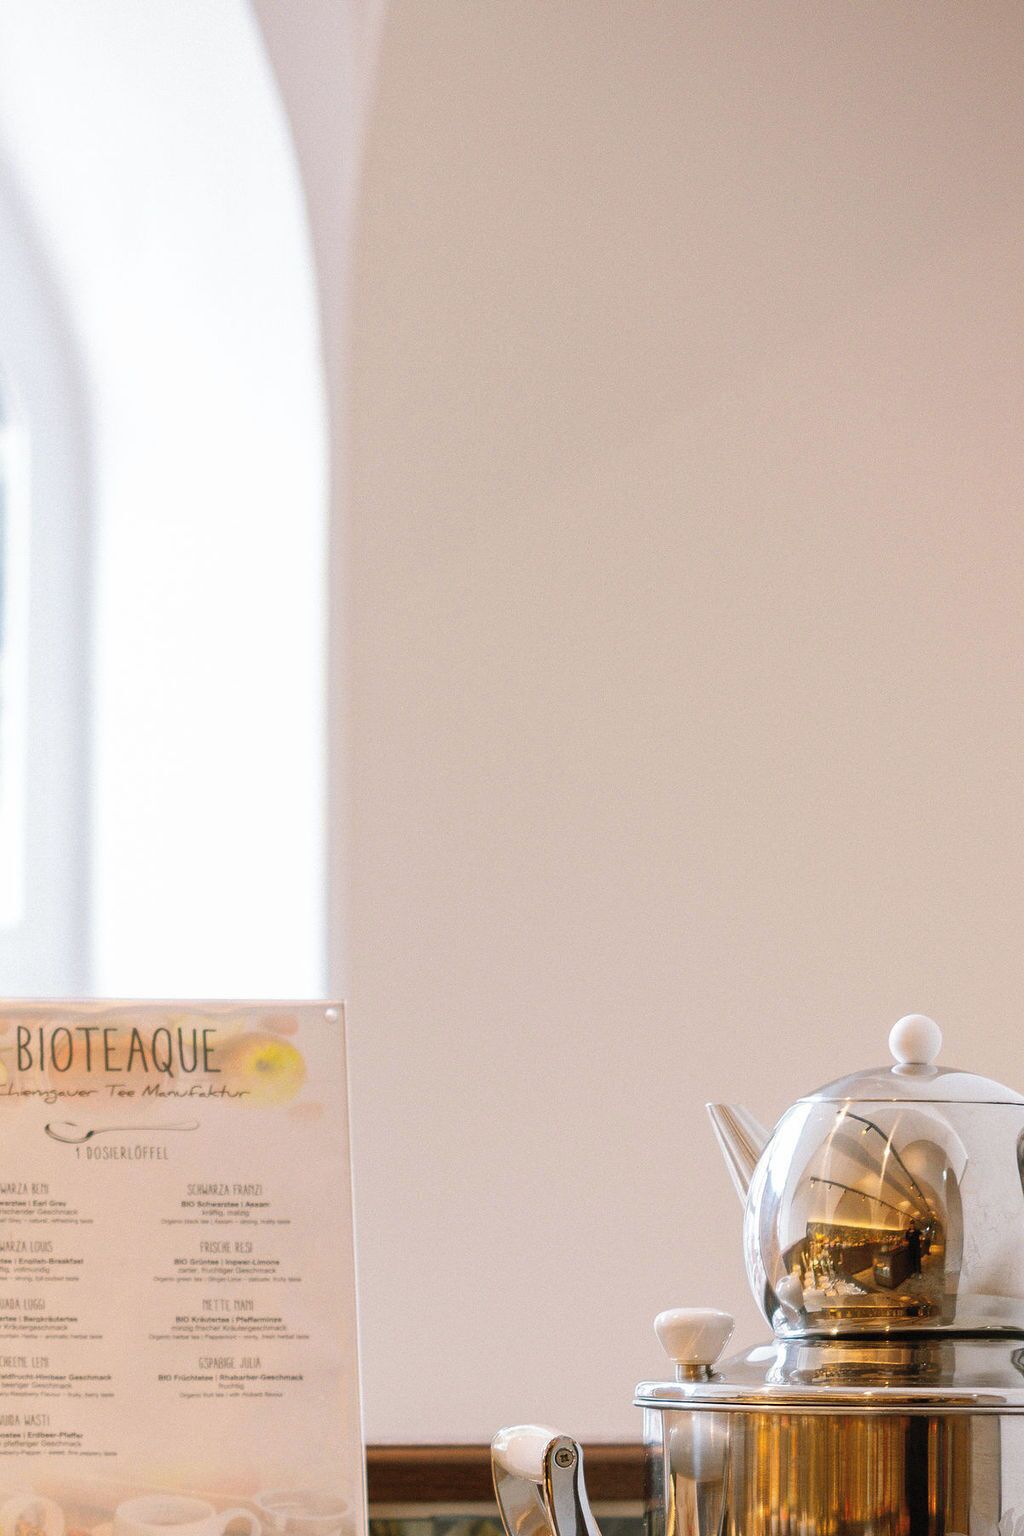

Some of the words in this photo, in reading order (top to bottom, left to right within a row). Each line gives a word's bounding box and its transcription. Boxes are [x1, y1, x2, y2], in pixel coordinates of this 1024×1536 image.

[16, 1026, 222, 1079] BIOTEAQUE
[105, 1084, 136, 1099] Tee
[142, 1083, 251, 1100] Manufaktur
[86, 1145, 169, 1161] DOSIERLÖFFEL
[186, 1183, 230, 1196] SCHWARZA
[181, 1200, 194, 1208] BIO
[199, 1241, 230, 1253] FRISCHE
[173, 1258, 188, 1266] BIO
[175, 1315, 189, 1324] BIO
[157, 1374, 172, 1382] BIO
